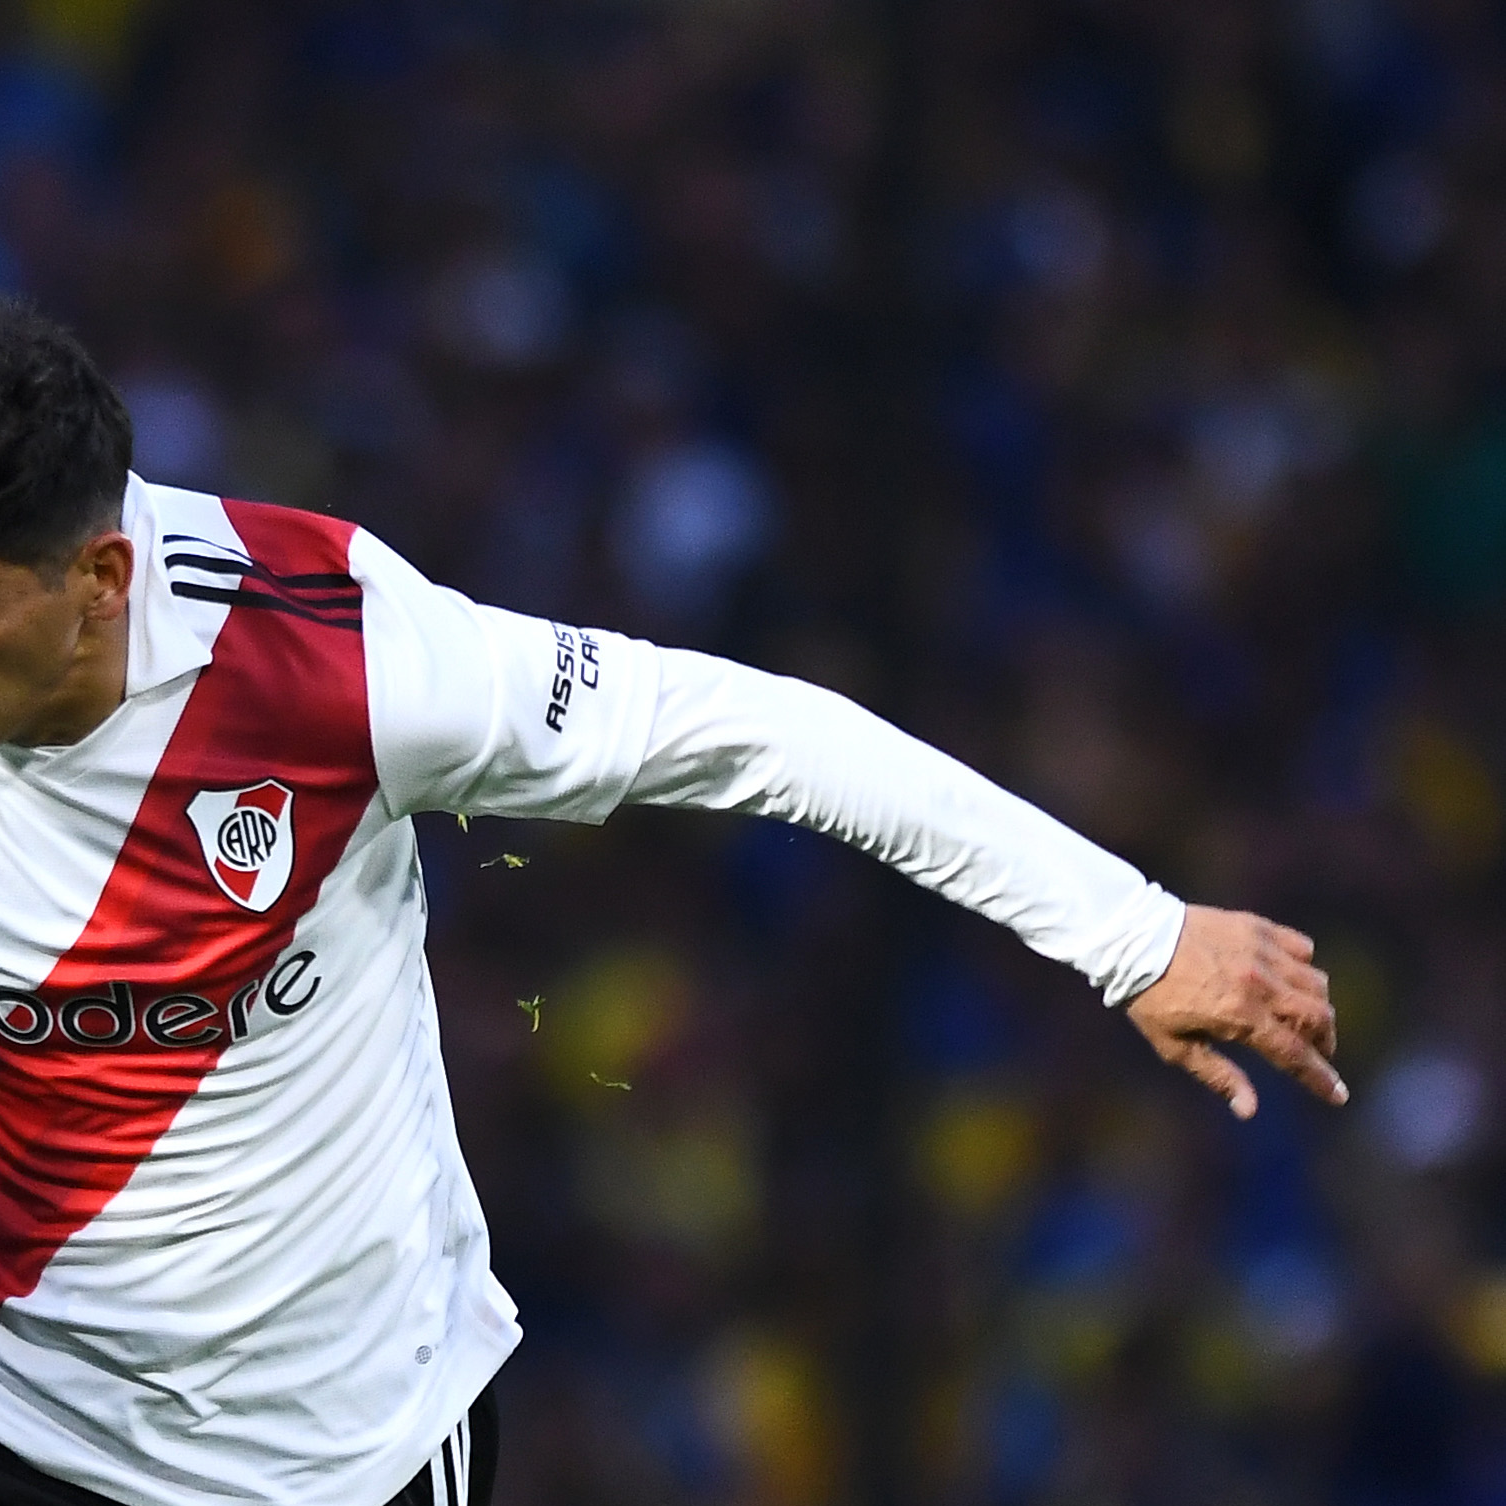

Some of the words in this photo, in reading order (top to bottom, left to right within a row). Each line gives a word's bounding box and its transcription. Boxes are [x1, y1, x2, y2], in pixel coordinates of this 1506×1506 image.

[545, 624, 575, 734] ASSIS
[579, 631, 600, 690] CAR
[217, 810, 277, 867] CARP
